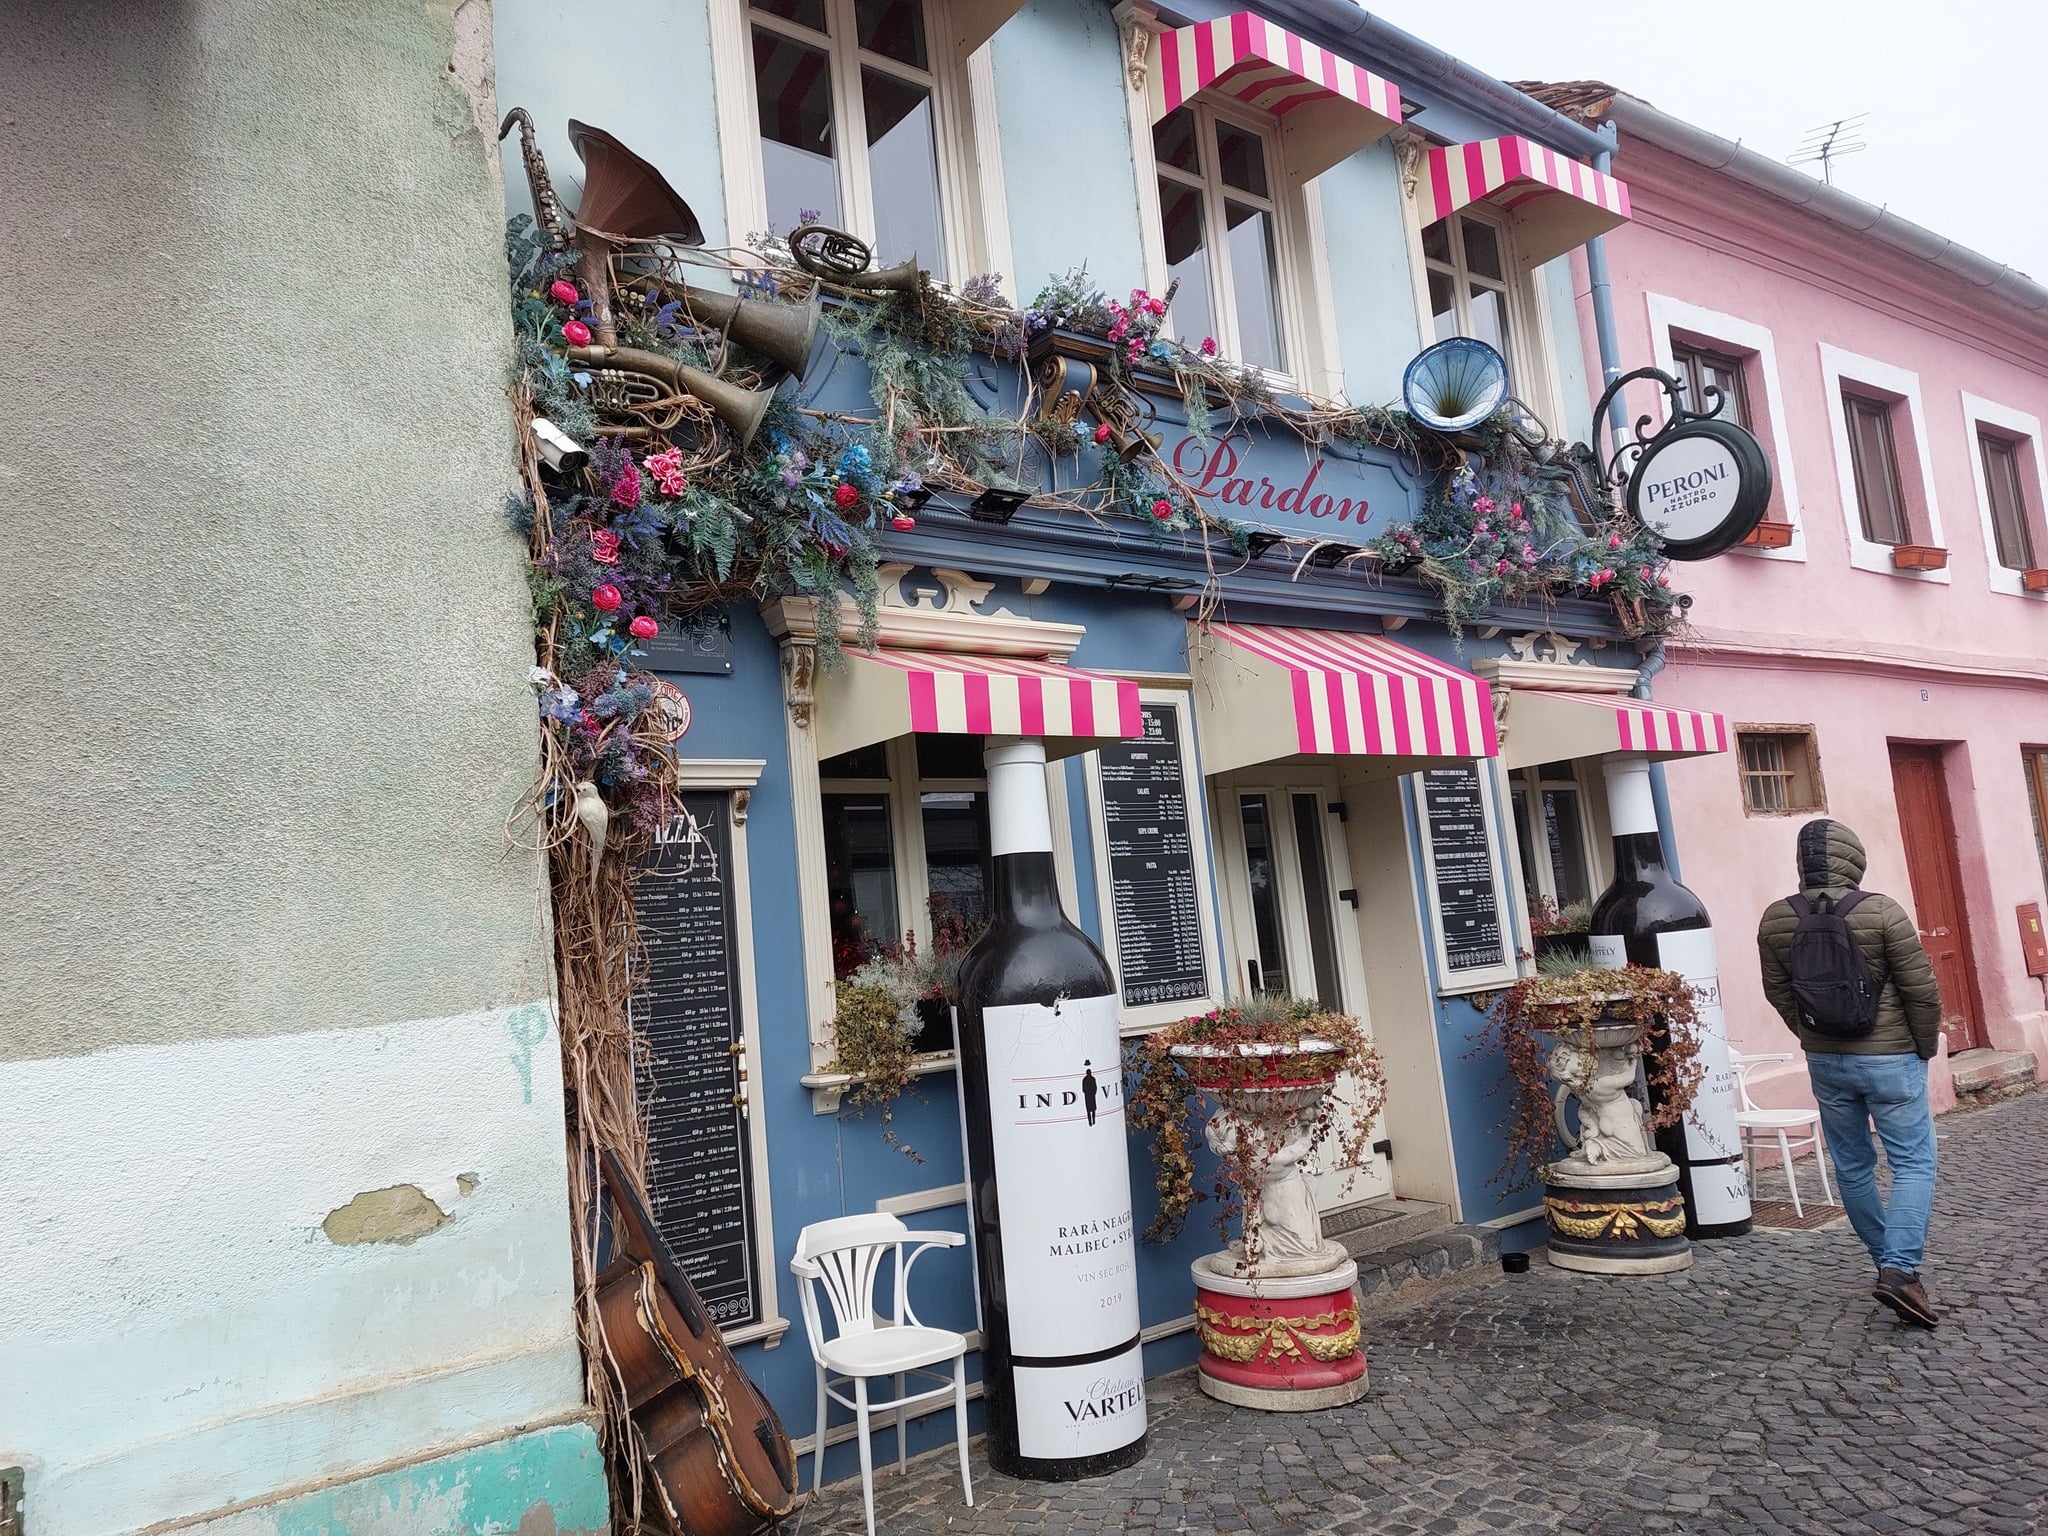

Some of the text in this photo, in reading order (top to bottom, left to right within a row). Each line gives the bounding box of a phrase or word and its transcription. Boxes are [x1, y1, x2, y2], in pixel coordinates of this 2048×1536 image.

[1168, 434, 1374, 525] Pardon
[1647, 463, 1726, 503] PERONI
[1663, 491, 1716, 514] AZZURRO
[1670, 488, 1706, 504] NASTRO
[1059, 1220, 1099, 1239] RARĂ
[1049, 1237, 1109, 1257] MALBEC
[1077, 1272, 1096, 1283] VIN
[1098, 1267, 1114, 1279] SEC
[1100, 1292, 1122, 1308] 2019
